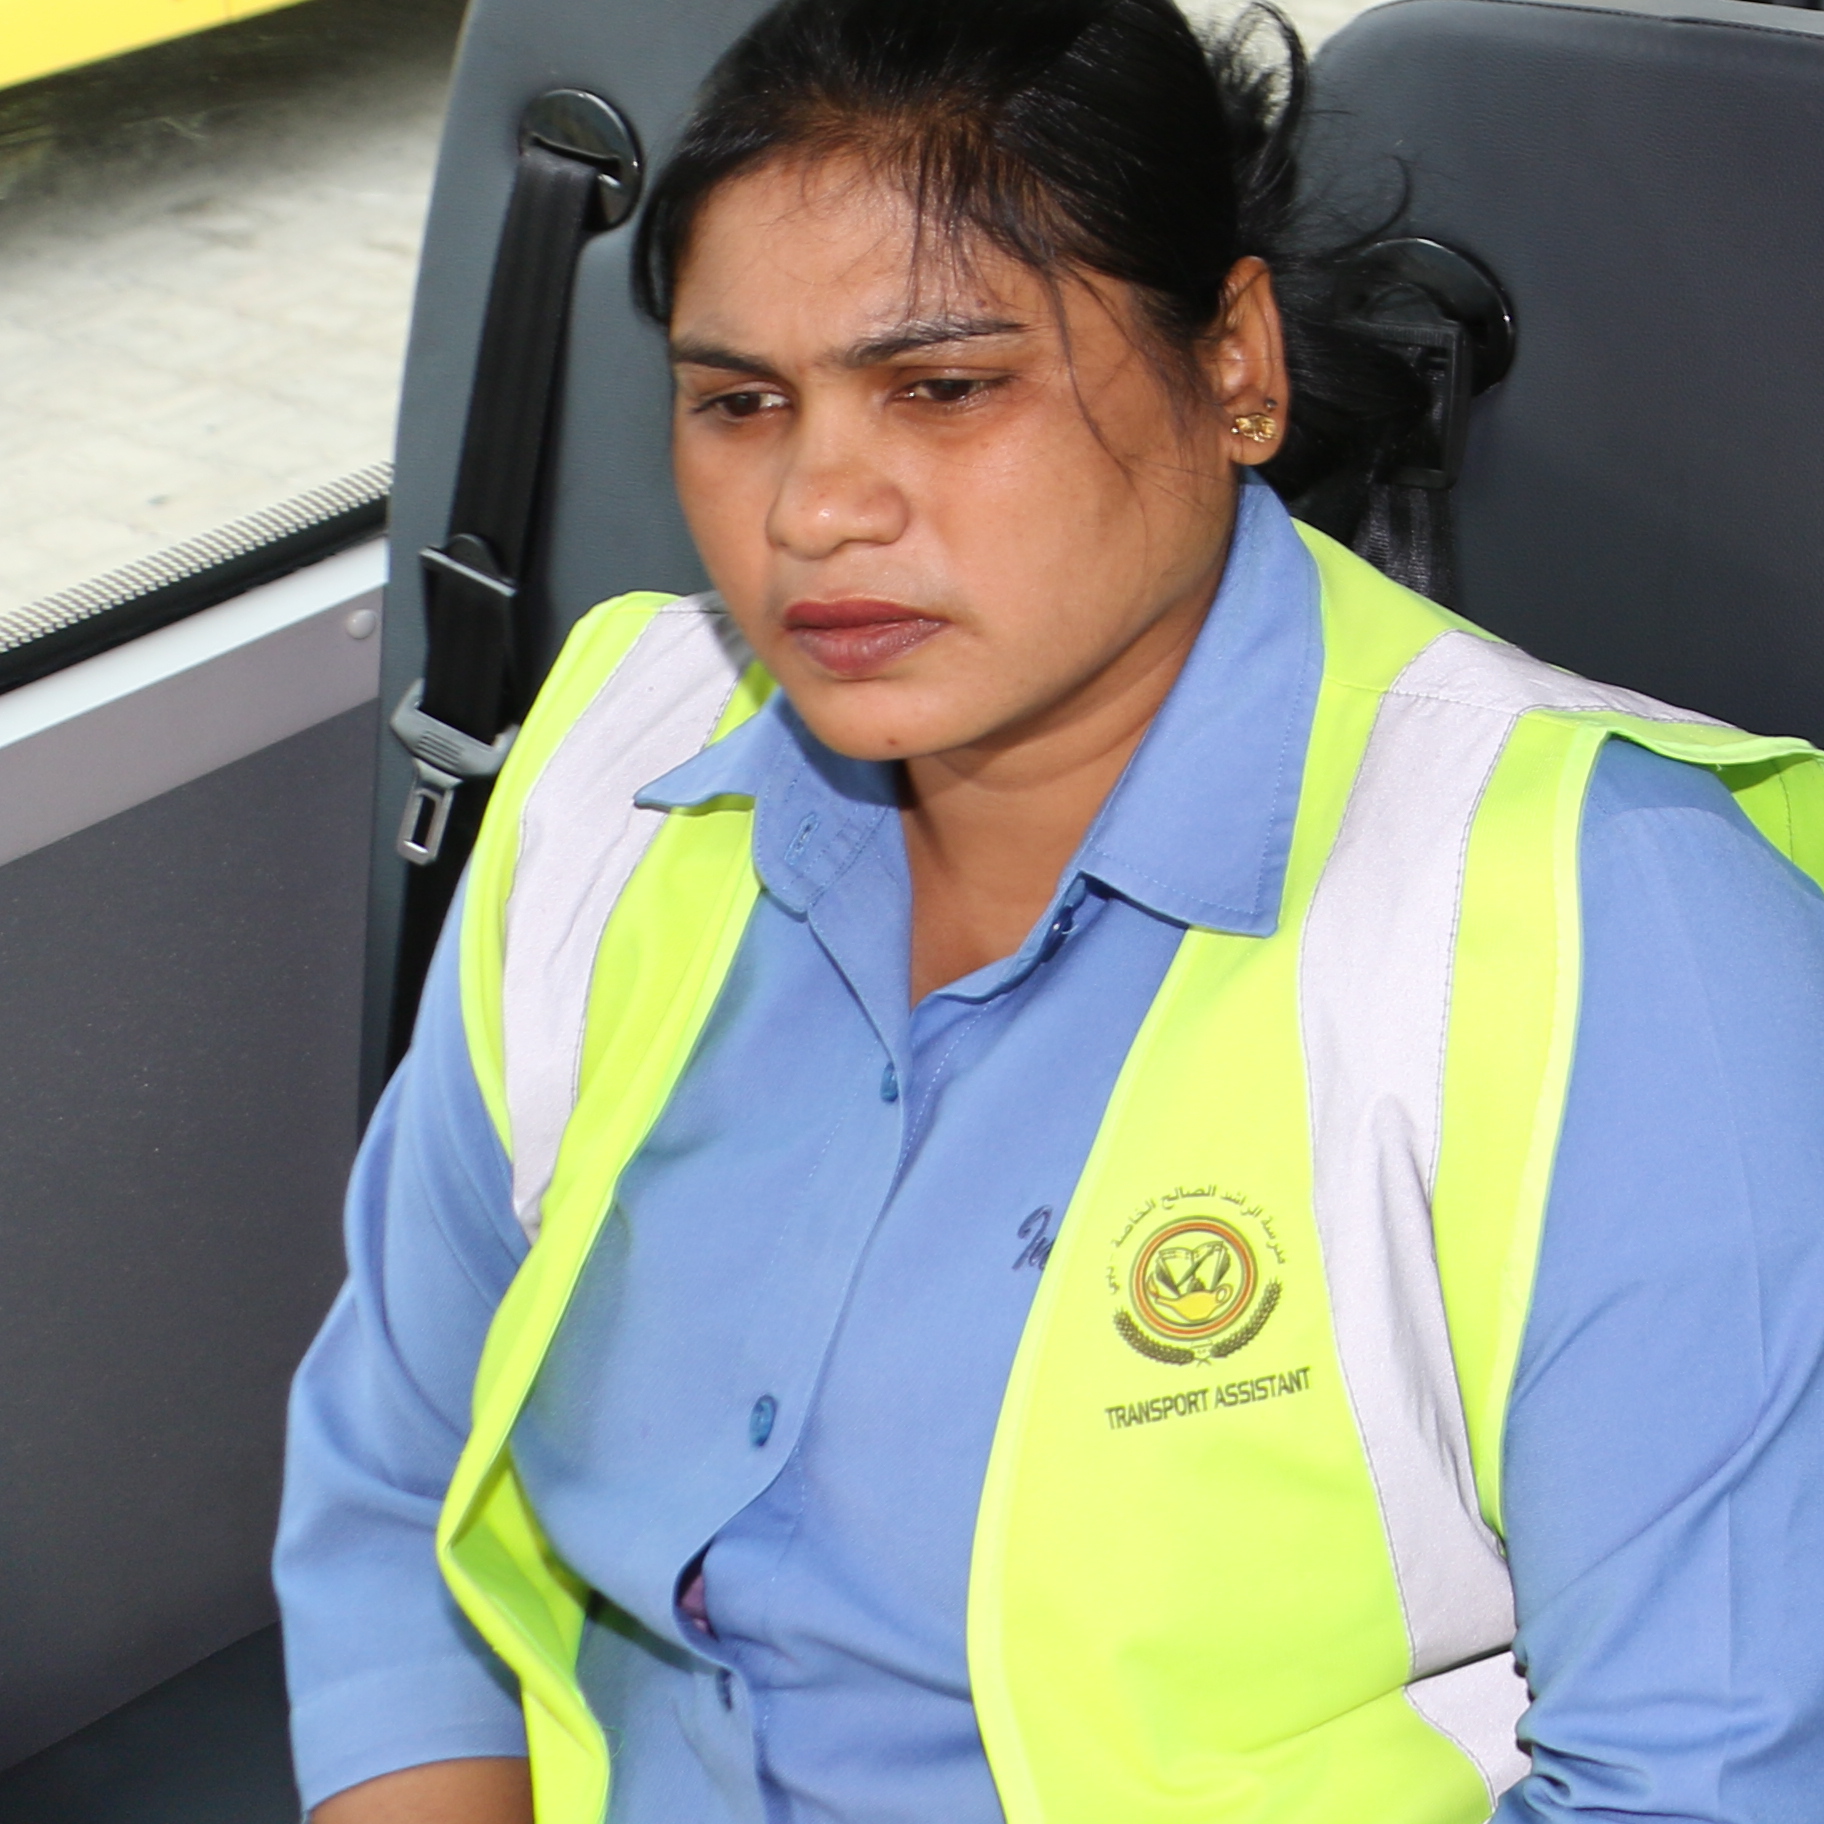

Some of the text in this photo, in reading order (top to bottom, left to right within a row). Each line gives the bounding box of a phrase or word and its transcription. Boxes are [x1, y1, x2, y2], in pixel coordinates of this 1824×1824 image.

[1161, 1184, 1217, 1210] الصالح
[1220, 1189, 1263, 1218] الراشد
[1111, 1198, 1156, 1248] الخاصة
[1260, 1216, 1286, 1265] مدرسة
[1104, 1366, 1311, 1430] TRANSPORT ASSISTANT
